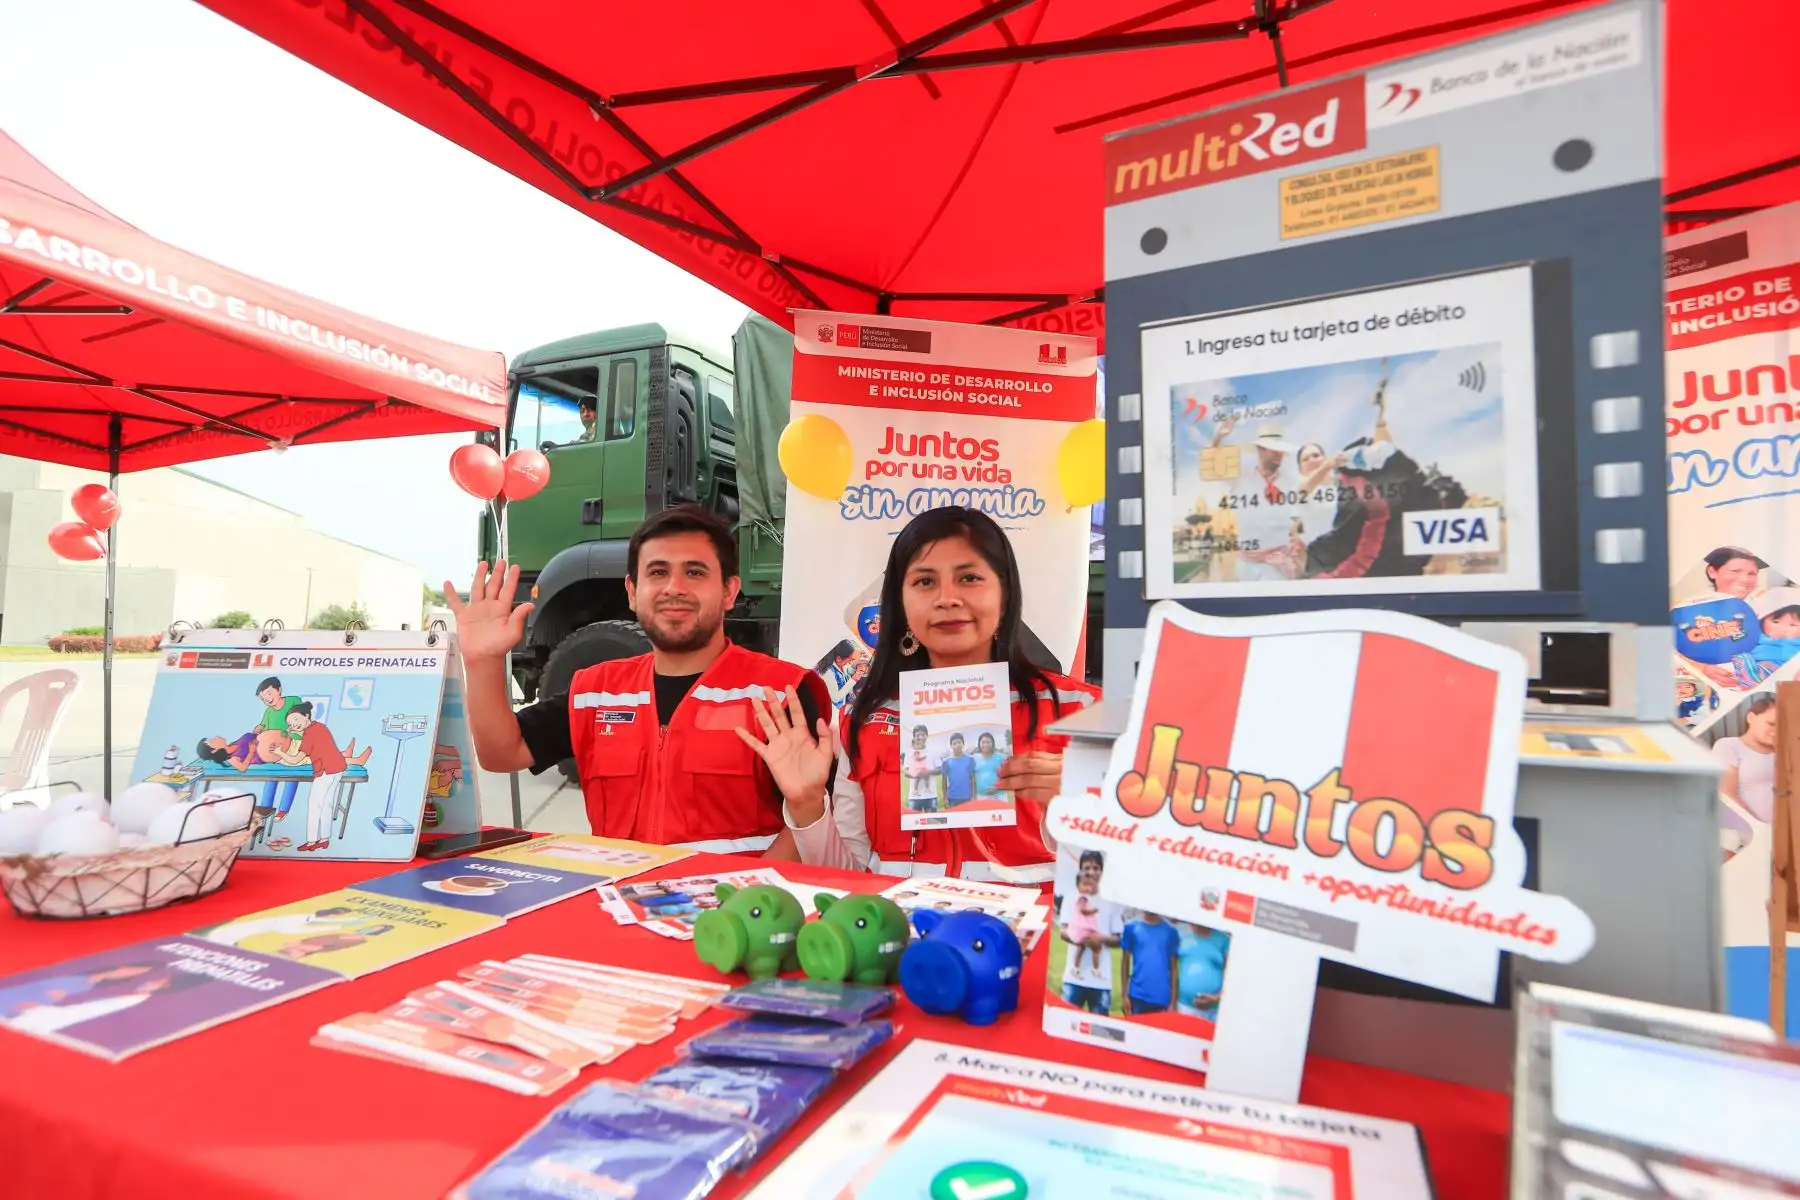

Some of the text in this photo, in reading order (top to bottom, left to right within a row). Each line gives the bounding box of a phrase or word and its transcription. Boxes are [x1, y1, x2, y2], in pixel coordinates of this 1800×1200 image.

[1430, 68, 1489, 95] Banco
[1753, 277, 1793, 296] DE
[1198, 333, 1265, 356] Ingresa
[1270, 329, 1289, 344] tu
[1293, 319, 1359, 342] tarjeta
[1364, 314, 1390, 332] de
[1395, 304, 1466, 328] débito
[226, 295, 248, 320] E
[256, 305, 409, 375] INCLUSIÓN
[411, 361, 498, 405] SOCIAL
[838, 365, 1053, 393] MINISTERIO DE DESARROLLO
[869, 385, 1022, 408] E INCLUSIÓN SOCIAL
[1737, 402, 1800, 426] un
[877, 426, 1000, 462] Juntos
[865, 459, 1012, 484] por una vida
[840, 484, 903, 520] sin
[1218, 493, 1260, 510] 4214
[1266, 489, 1309, 506] 1002
[1411, 517, 1489, 545] VISA
[279, 657, 437, 667] CONTROLES PRENATALES
[913, 684, 995, 706] JUNTOS
[923, 679, 954, 688] Programa
[1116, 724, 1495, 890] Juntos
[464, 862, 564, 884] SANGRECITA
[1059, 813, 1139, 843] +salud
[1146, 835, 1290, 881] +educación
[1302, 873, 1558, 946] +oportunidades
[921, 881, 1011, 899] JUNTOS
[957, 1056, 1034, 1079] Marca
[1039, 1070, 1079, 1085] NO
[1083, 1078, 1145, 1098] para
[1243, 1105, 1271, 1121] tu
